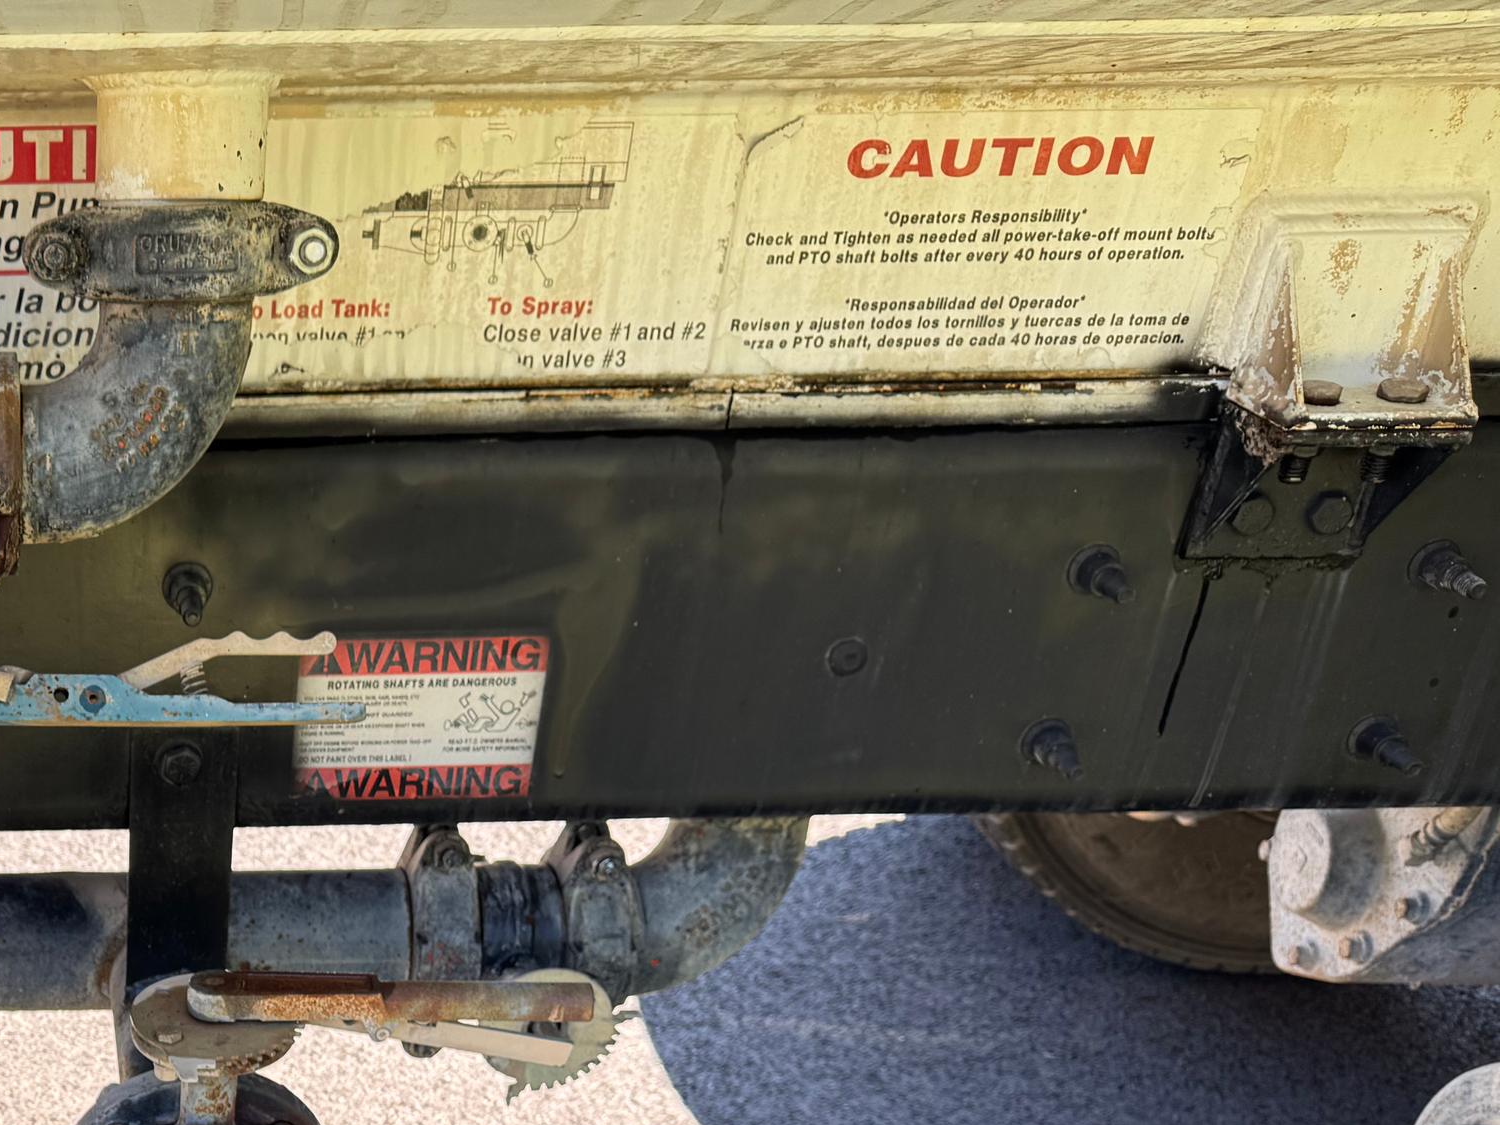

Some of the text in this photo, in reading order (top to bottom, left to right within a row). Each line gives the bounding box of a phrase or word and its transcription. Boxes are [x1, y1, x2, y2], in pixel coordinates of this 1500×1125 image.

[846, 135, 1156, 180] CAUTION
[31, 191, 100, 220] Pu
[745, 231, 794, 247] Check
[799, 231, 829, 246] and
[833, 230, 891, 248] Tighten
[896, 232, 915, 244] as
[918, 228, 978, 244] needed
[981, 228, 1001, 243] all
[1003, 226, 1121, 245] power-take-off
[1123, 226, 1174, 241] mount
[765, 245, 1185, 266] and PTO shaft bolts after every 40 hours of operation.
[14, 287, 44, 315] la
[55, 291, 99, 314] bo
[270, 298, 324, 320] Load
[331, 298, 391, 319] Tank:
[487, 295, 594, 319] To Spray:
[980, 295, 1004, 310] del
[483, 321, 707, 343] Close valve #1 and #2
[729, 311, 1191, 334] Revisen y ajusten todos los tornillos y tuercas de la toma de
[792, 335, 825, 349] PTO
[829, 334, 872, 351] shaft,
[877, 333, 941, 350] despues
[945, 333, 964, 348] de
[969, 332, 1007, 347] cada
[1010, 332, 1031, 346] 40
[1034, 331, 1078, 346] horas
[1082, 331, 1101, 346] de
[1105, 330, 1185, 348] operacion.
[542, 349, 595, 369] valve
[601, 349, 627, 369] #3
[345, 637, 542, 674] WARNING
[327, 676, 518, 691] ROTATING SHAFTS ARE DANGEROUS
[310, 755, 325, 764] NOT
[348, 755, 369, 764] OVER
[384, 754, 408, 763] LABEL
[334, 765, 524, 799] WARNING
